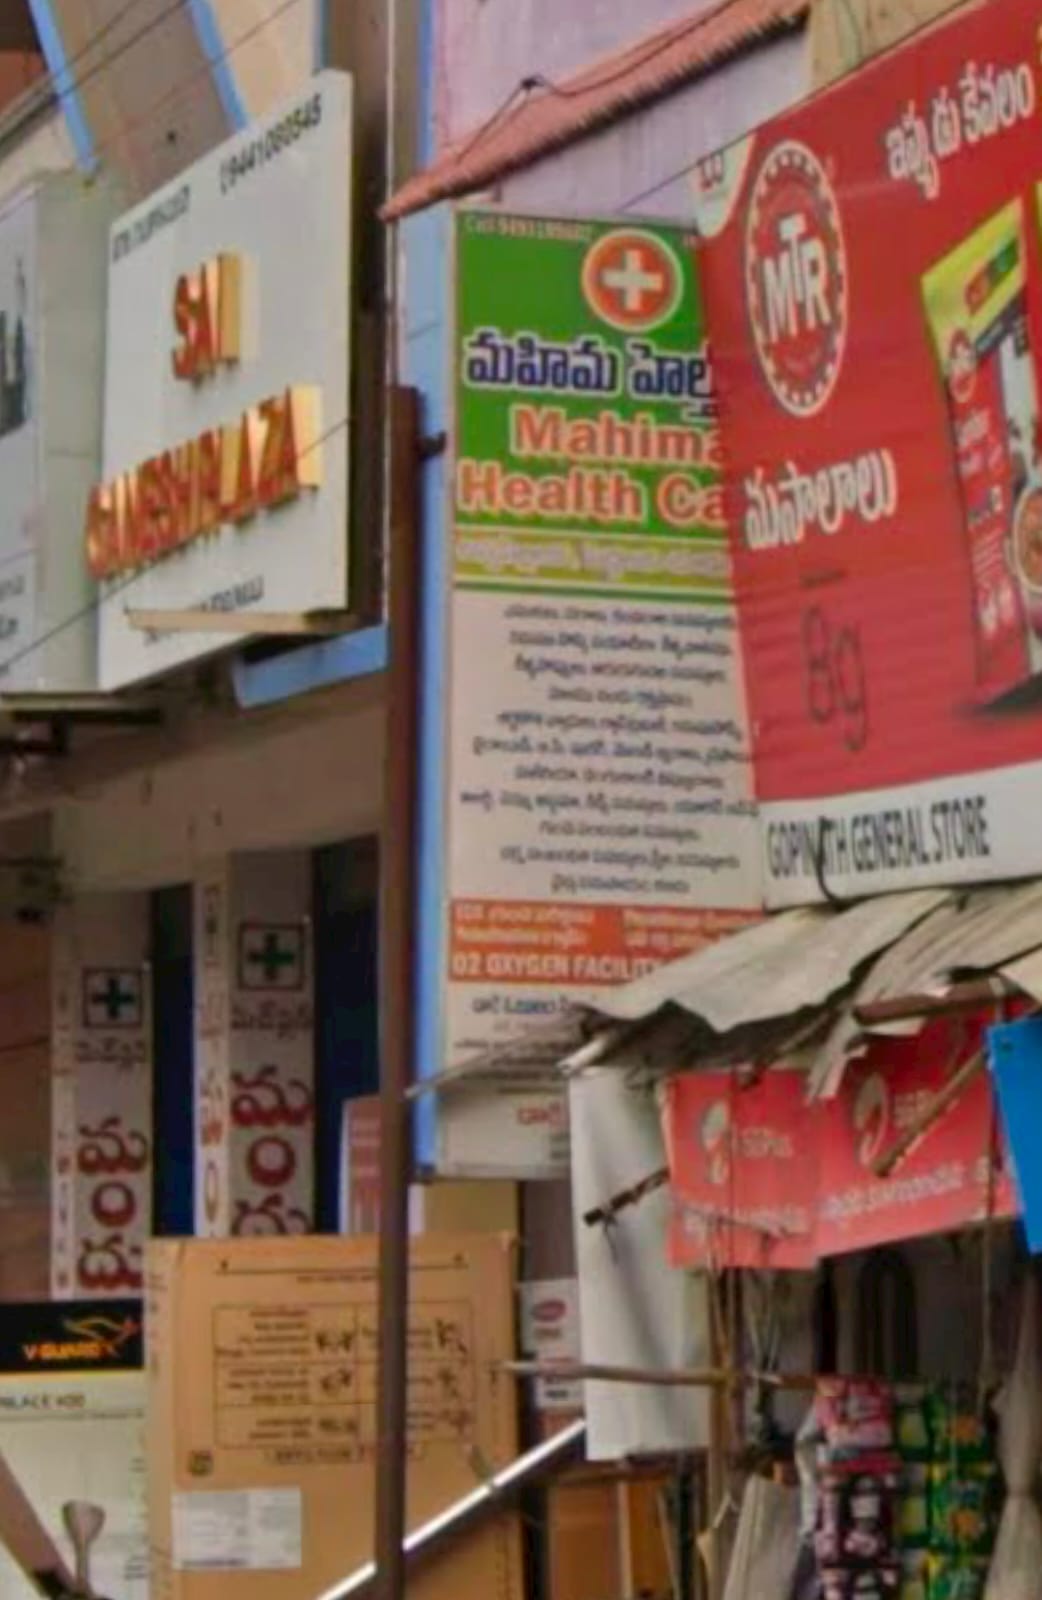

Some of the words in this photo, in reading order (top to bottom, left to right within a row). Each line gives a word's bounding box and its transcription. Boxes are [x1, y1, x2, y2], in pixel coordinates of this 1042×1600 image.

[763, 212, 831, 344] MTR
[464, 328, 622, 394] మహిమ
[457, 458, 647, 526] Health
[767, 814, 849, 880] GOPINTH
[851, 806, 929, 873] GENERAL
[930, 795, 990, 863] STORE
[486, 952, 569, 979] OXYGEN
